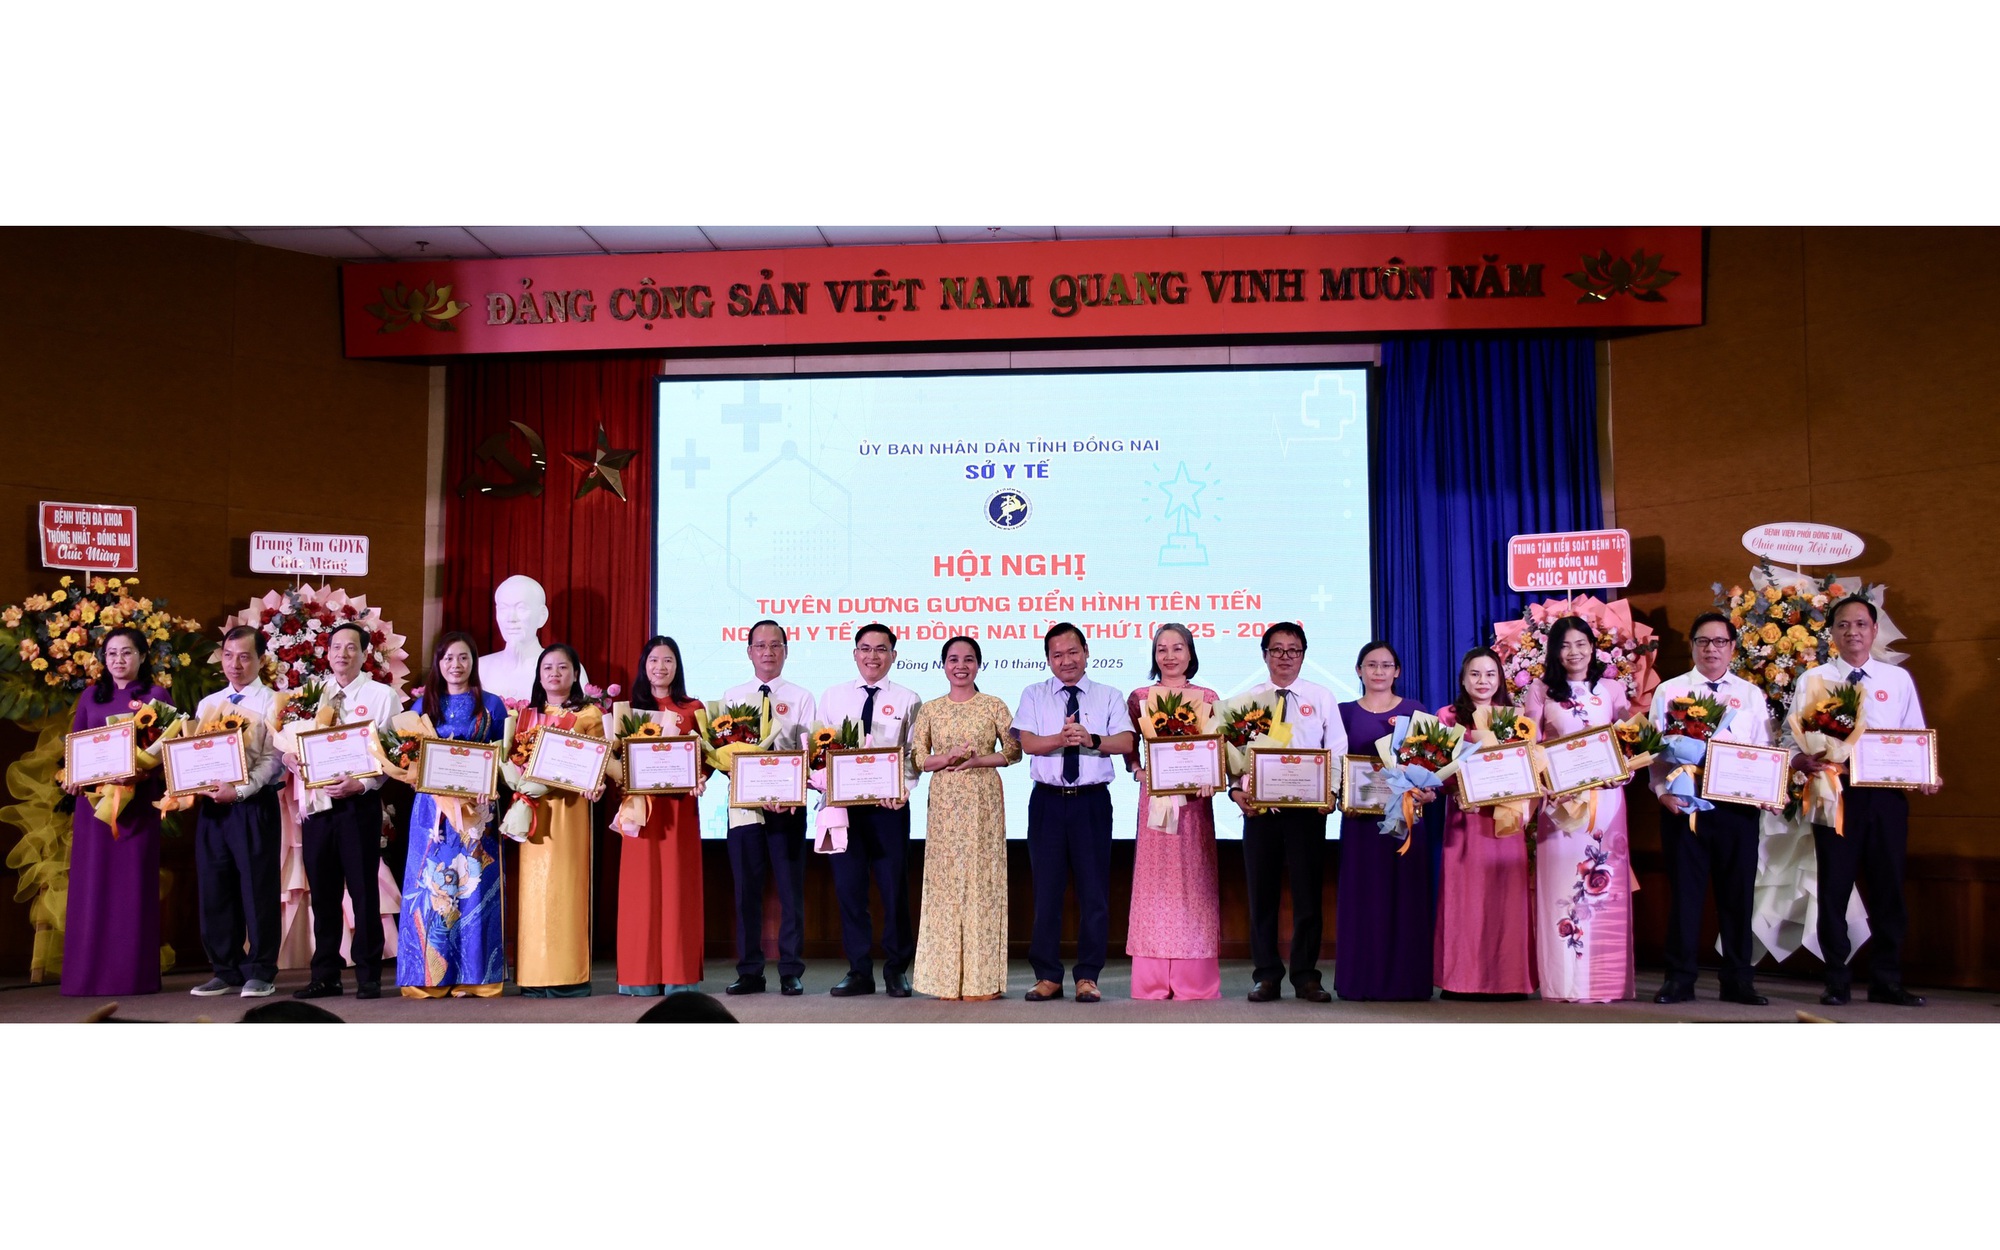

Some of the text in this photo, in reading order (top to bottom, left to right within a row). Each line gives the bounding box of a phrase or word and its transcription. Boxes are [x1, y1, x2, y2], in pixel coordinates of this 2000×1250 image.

[487, 254, 1545, 331] ĐẢNG CỘNG SẢN VIỆT NAM QUANG VINH MUÔN NĂM
[859, 436, 1160, 455] ỦY BAN NHÂN DÂN TỈNH ĐỒNG NAI
[965, 458, 1051, 479] SỞ Y TẾ
[54, 507, 123, 527] BỆNH VIỆN ĐA KHOA
[47, 524, 71, 544] THỐNG
[72, 527, 91, 545] NHẤT
[118, 533, 131, 547] NAI
[255, 535, 365, 555] Trung Tâm GĐYK
[1513, 542, 1536, 555] TRUNG
[1538, 540, 1552, 553] TÂM
[1572, 537, 1590, 552] SOÁT
[1592, 536, 1610, 553] BỆNH
[1831, 532, 1843, 540] NAI
[57, 544, 121, 568] Chúc Mừng
[1807, 541, 1828, 555] Hội
[1829, 544, 1853, 557] nghị
[933, 550, 1087, 582] HỘI NGHỊ
[1537, 554, 1556, 568] TỈNH
[1584, 555, 1598, 567] NAI
[1527, 567, 1607, 586] CHÚC MỪNG
[757, 586, 1262, 614] TUYÊN DƯƠNG GƯƠNG ĐIỂN HÌNH TIÊN TIẾN
[722, 626, 800, 642] NGH
[806, 626, 818, 640] Y
[826, 620, 855, 640] TẾ
[916, 620, 978, 640] ĐỒNG
[987, 625, 1026, 639] NAI
[1082, 619, 1132, 639] THỨ
[1133, 624, 1142, 638] I
[897, 658, 928, 672] Đồng
[994, 659, 1008, 669] 10
[1012, 658, 1046, 671] tháng
[1092, 659, 1124, 669] 2025
